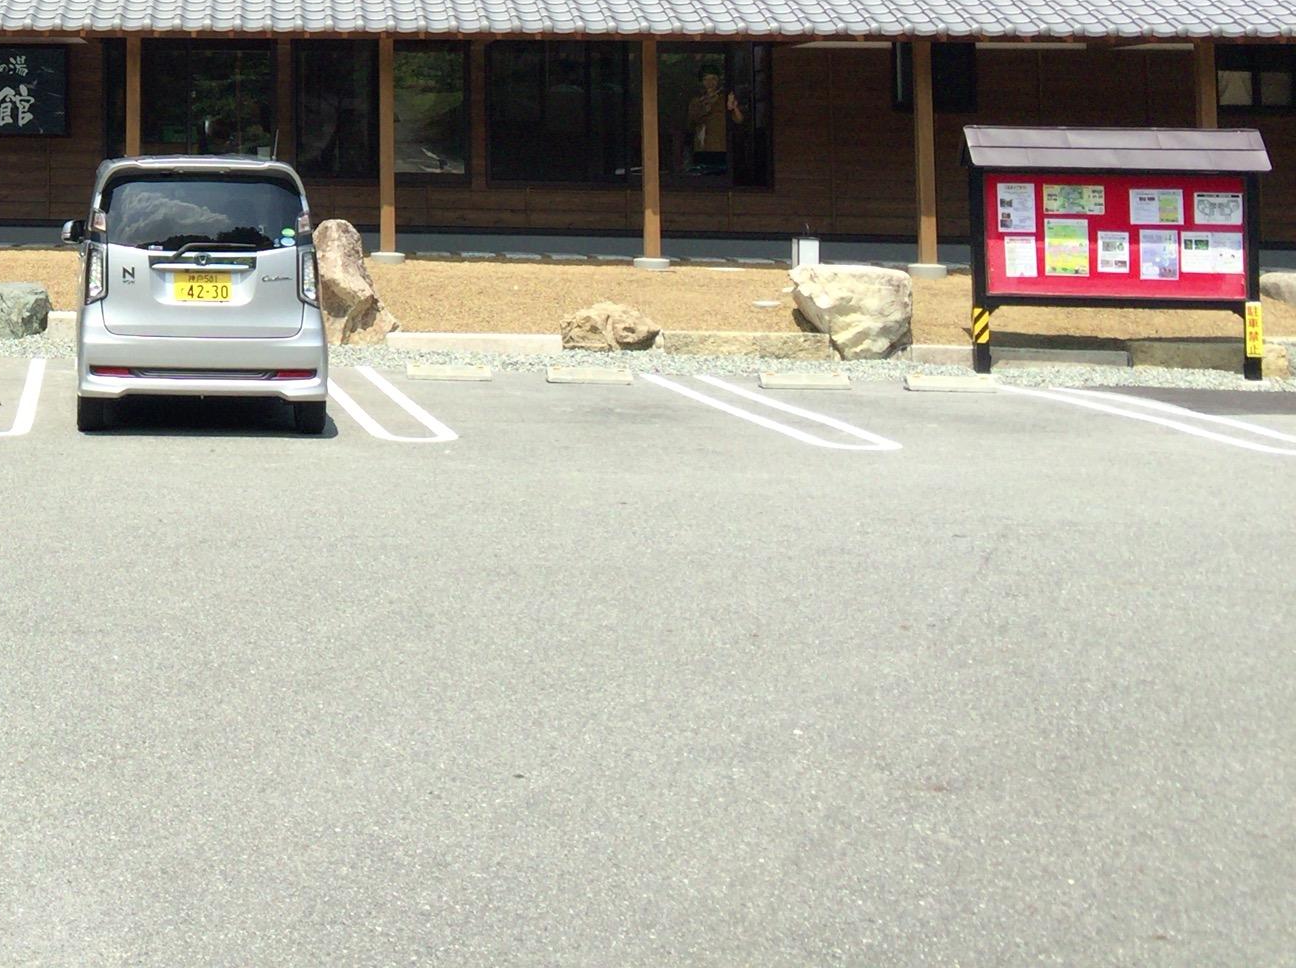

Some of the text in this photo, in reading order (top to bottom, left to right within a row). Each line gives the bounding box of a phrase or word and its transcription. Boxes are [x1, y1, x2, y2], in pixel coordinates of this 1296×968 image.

[122, 266, 135, 279] N
[187, 284, 228, 299] 42-30
[1247, 305, 1261, 355] 駐車禁止
